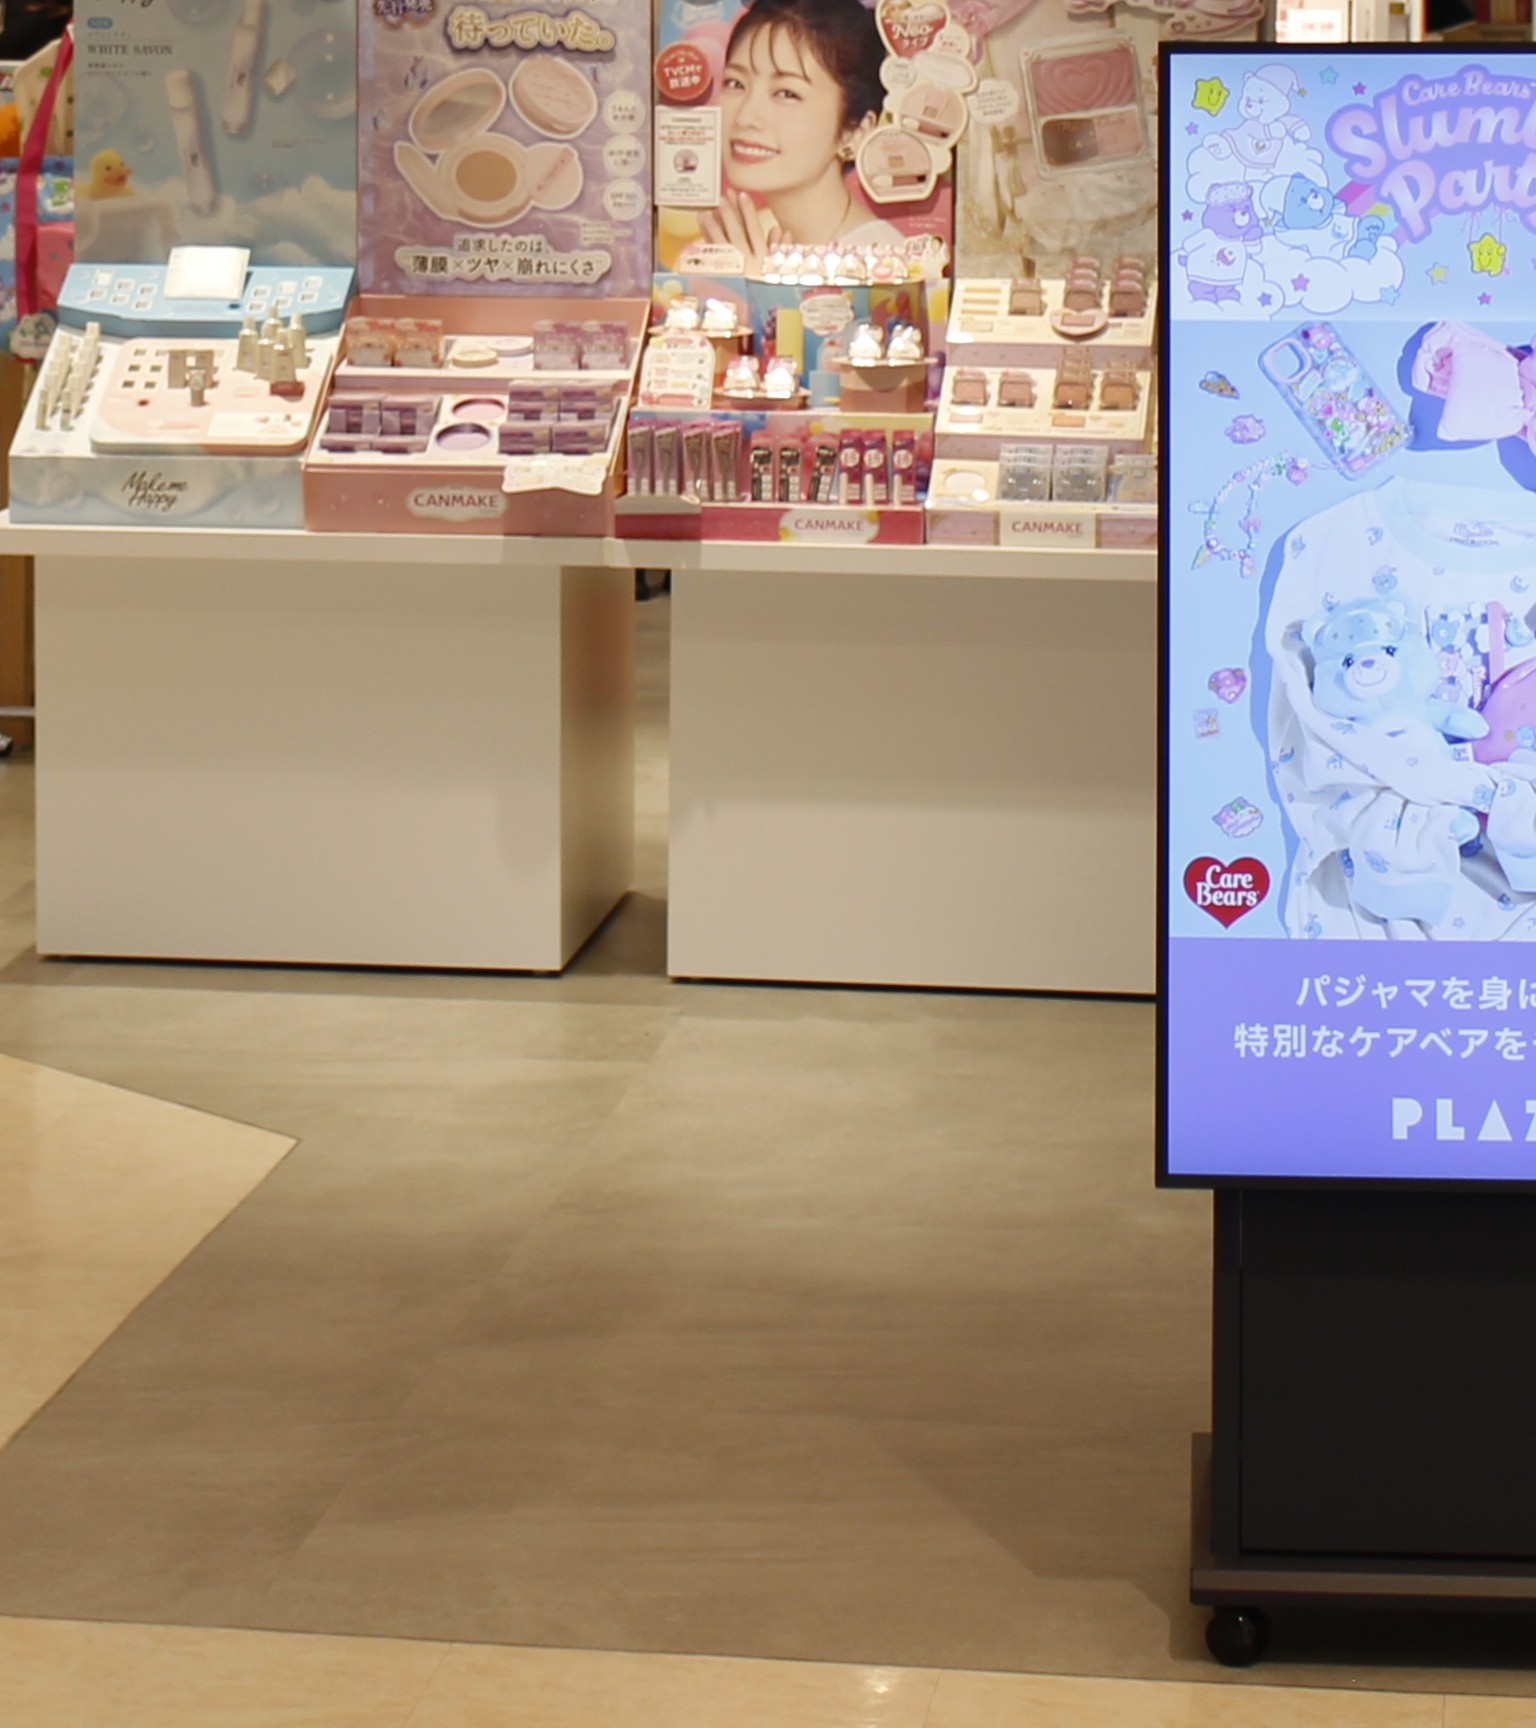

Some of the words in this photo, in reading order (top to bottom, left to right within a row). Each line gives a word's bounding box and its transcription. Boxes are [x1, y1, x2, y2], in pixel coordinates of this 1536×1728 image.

[453, 8, 614, 46] 待っていた。
[891, 23, 933, 39] Neo
[87, 44, 130, 56] WHITE
[132, 44, 173, 56] SAVON
[1401, 75, 1461, 106] Care
[121, 471, 166, 493] Make
[127, 489, 178, 512] Happy
[413, 493, 499, 508] CANMAKE
[794, 518, 864, 532] CANMAKE
[1011, 520, 1083, 534] CANMAKE
[1205, 864, 1254, 889] Care
[1195, 881, 1259, 907] Bears
